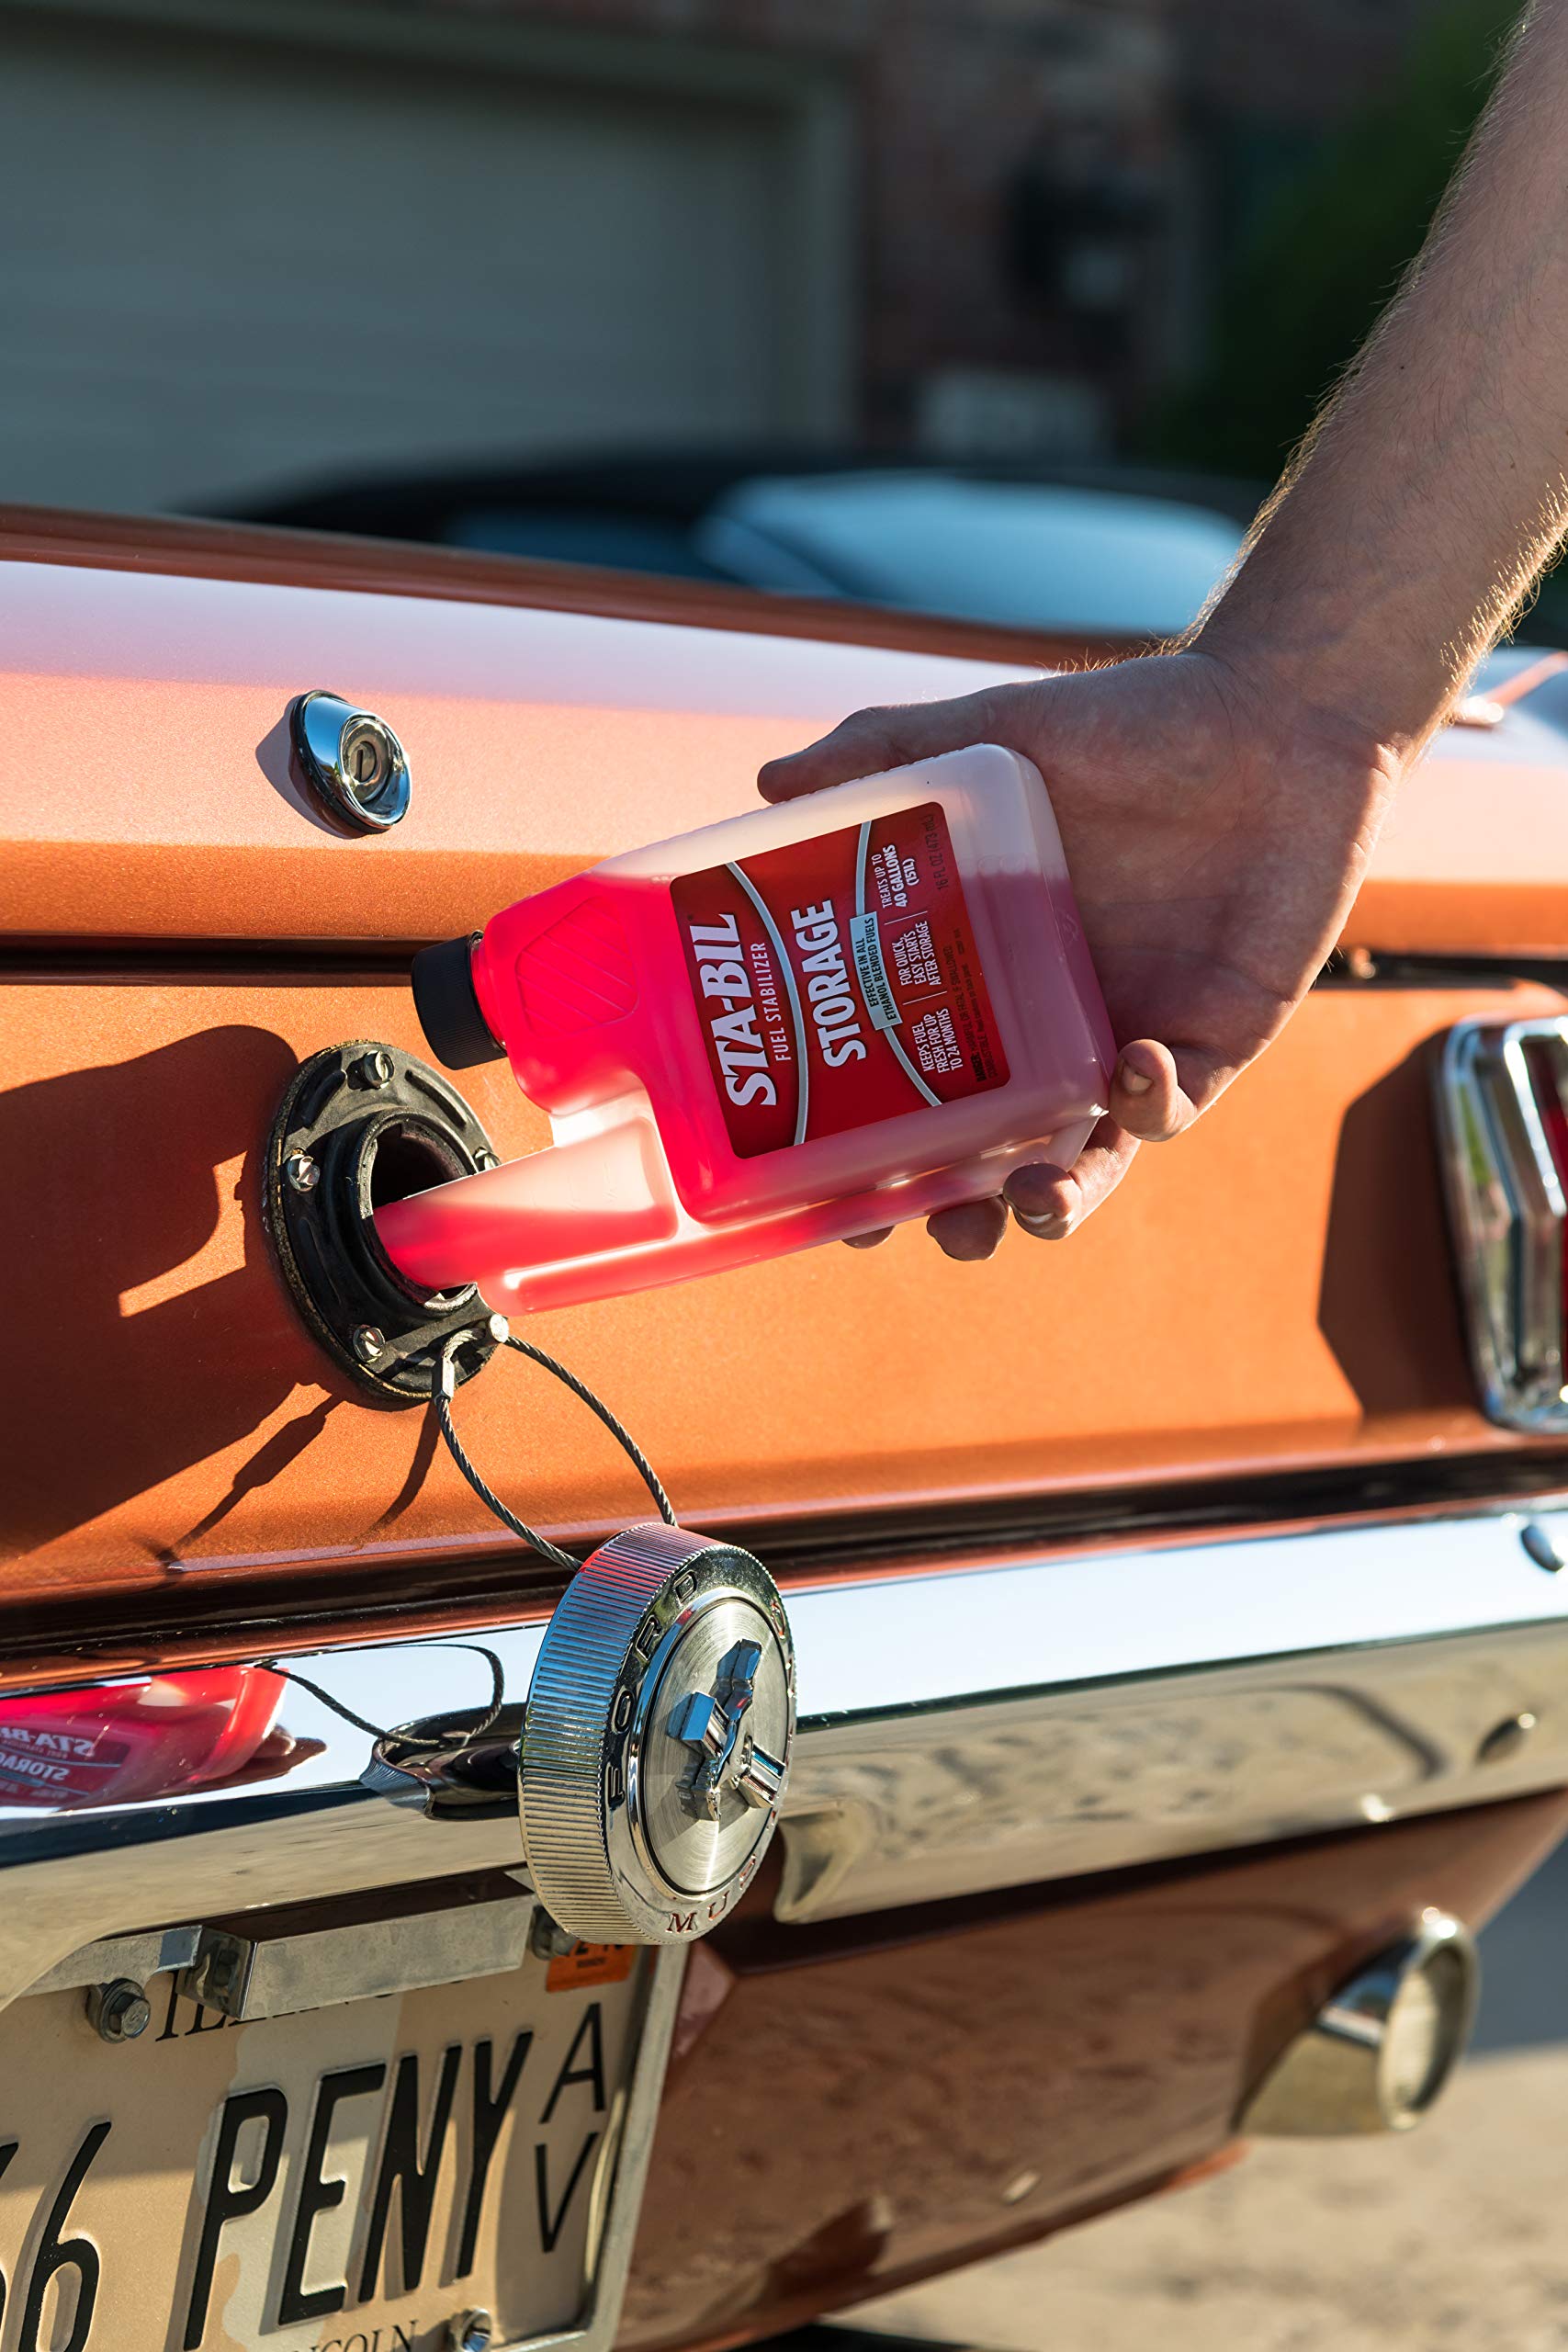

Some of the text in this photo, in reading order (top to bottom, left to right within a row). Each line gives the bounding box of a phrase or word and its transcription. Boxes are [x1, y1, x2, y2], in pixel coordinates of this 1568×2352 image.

[871, 854, 893, 909] TREATS UP TO
[883, 844, 908, 908] 40 GALLONS
[902, 858, 919, 886] (151L)
[791, 900, 866, 1067] STORAGE
[855, 938, 879, 1007] EFFECTIVE IN ALL
[864, 918, 897, 1020] ETHANOL BLENDED FUELS
[892, 937, 913, 986] FOR QUICK,
[904, 931, 927, 985] EASY STARTS
[915, 921, 942, 986] AFTER STORAGE
[690, 914, 776, 1105] STA-BIL
[750, 943, 791, 1061] FUEL STABILIZER
[912, 1022, 935, 1072] KEEPS FUEL
[923, 1014, 950, 1074] FRESH FOR UP
[936, 1008, 964, 1070] TO 24 MONTHS
[604, 1569, 698, 1812] FORD
[0, 2121, 111, 2352] 6
[184, 2031, 533, 2351] PENY
